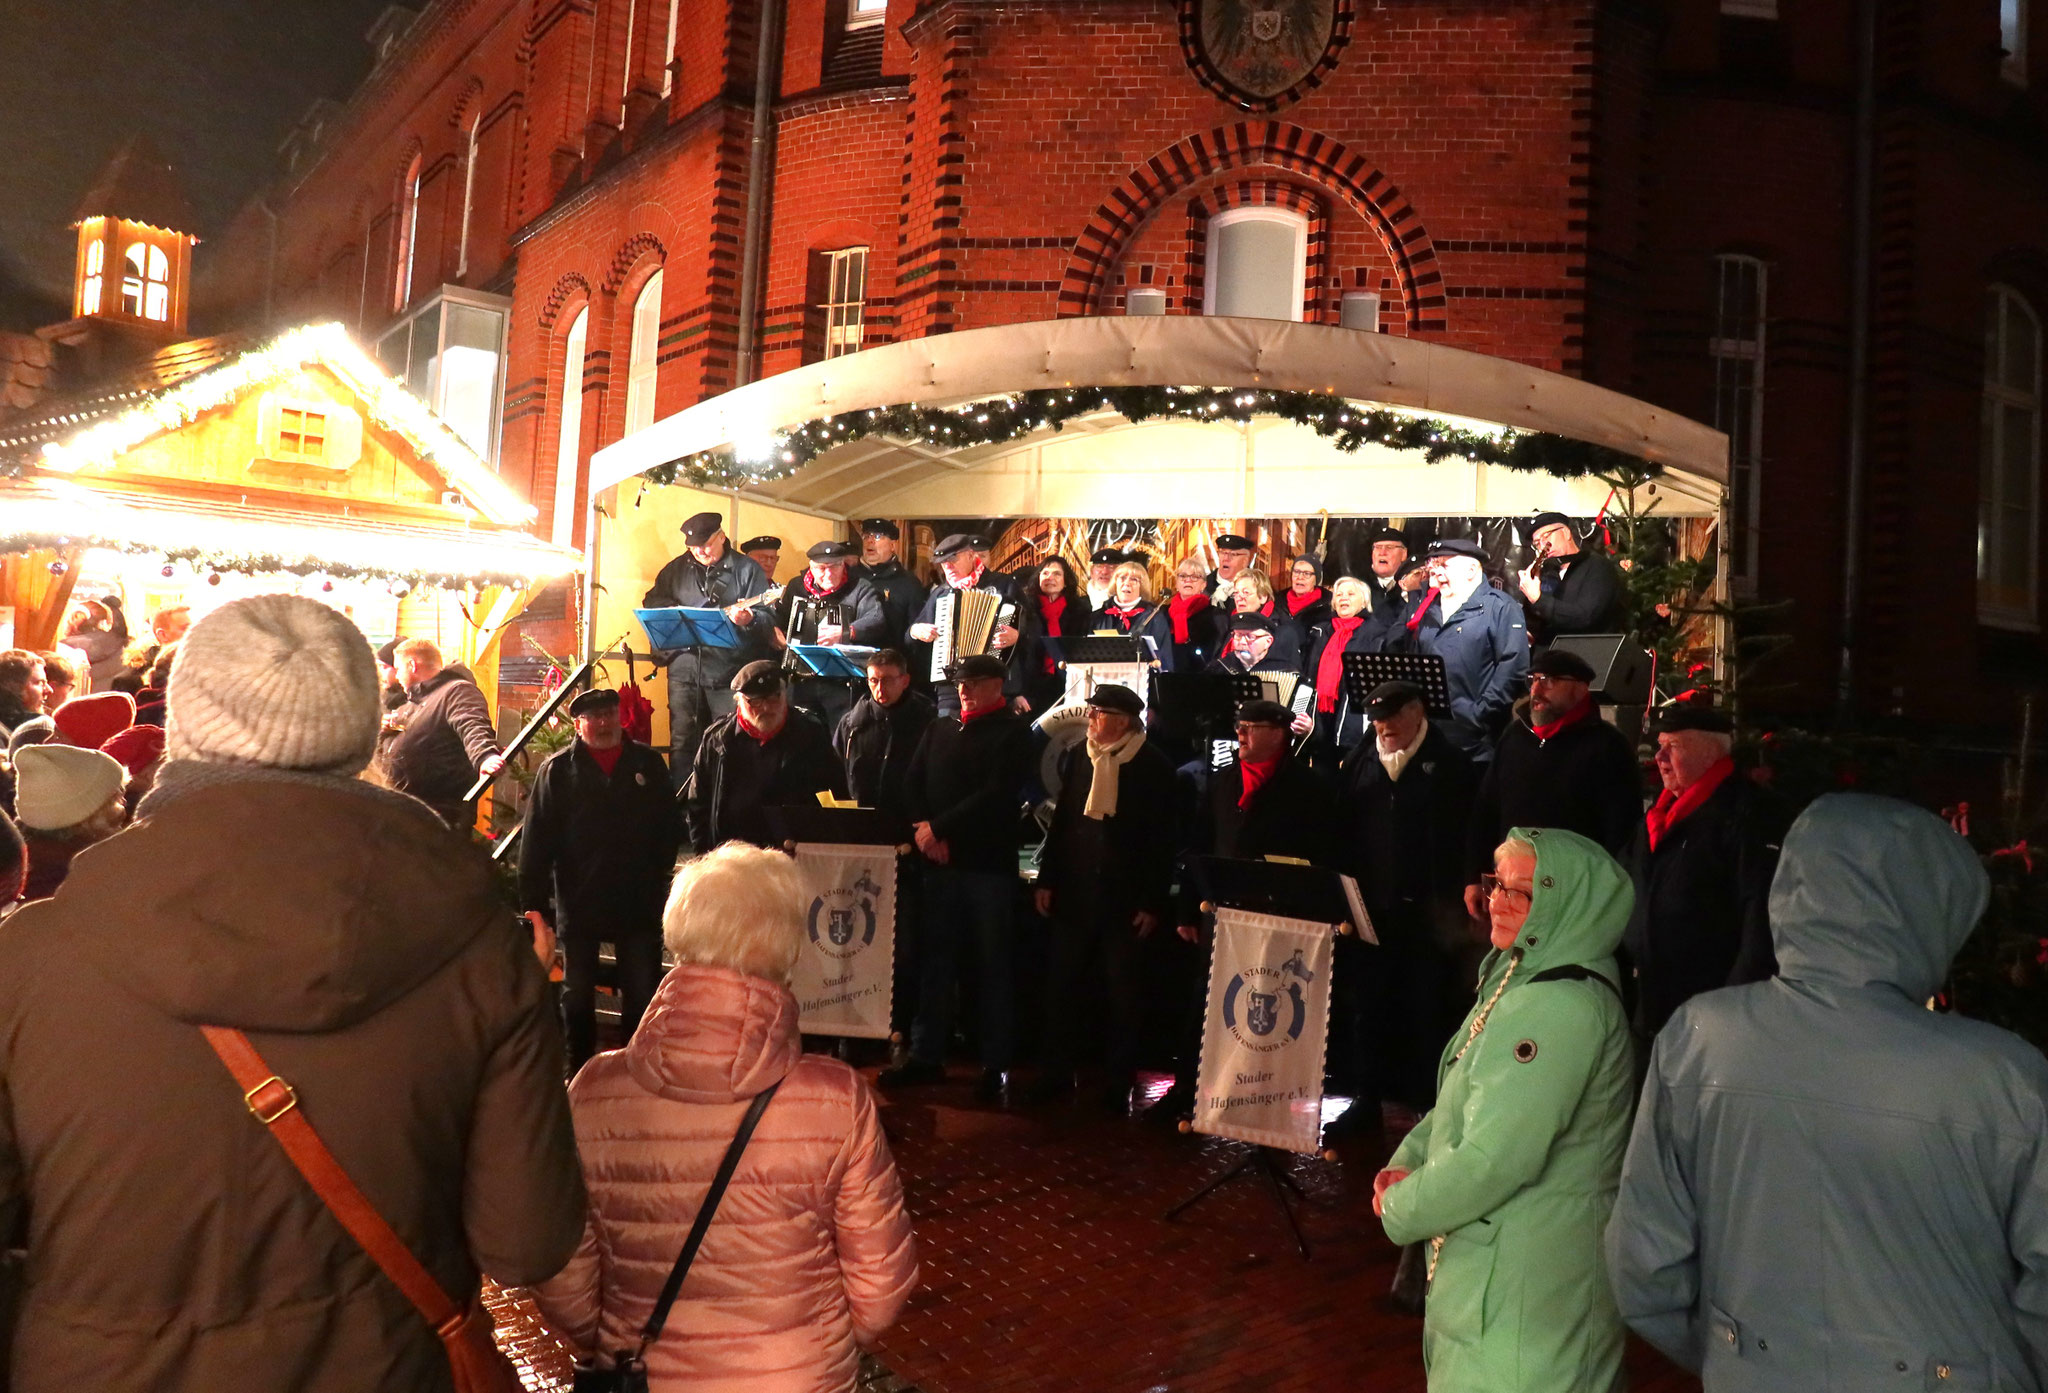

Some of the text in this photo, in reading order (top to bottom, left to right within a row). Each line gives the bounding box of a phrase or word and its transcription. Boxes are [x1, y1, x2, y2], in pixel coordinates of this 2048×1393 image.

[1052, 706, 1088, 722] STADE
[823, 974, 854, 989] Stader
[1243, 967, 1281, 980] STADER
[803, 982, 882, 1012] Hafensänger e.V.
[1235, 1069, 1274, 1085] Stader
[1210, 1086, 1309, 1110] Hafensänger e.V.
